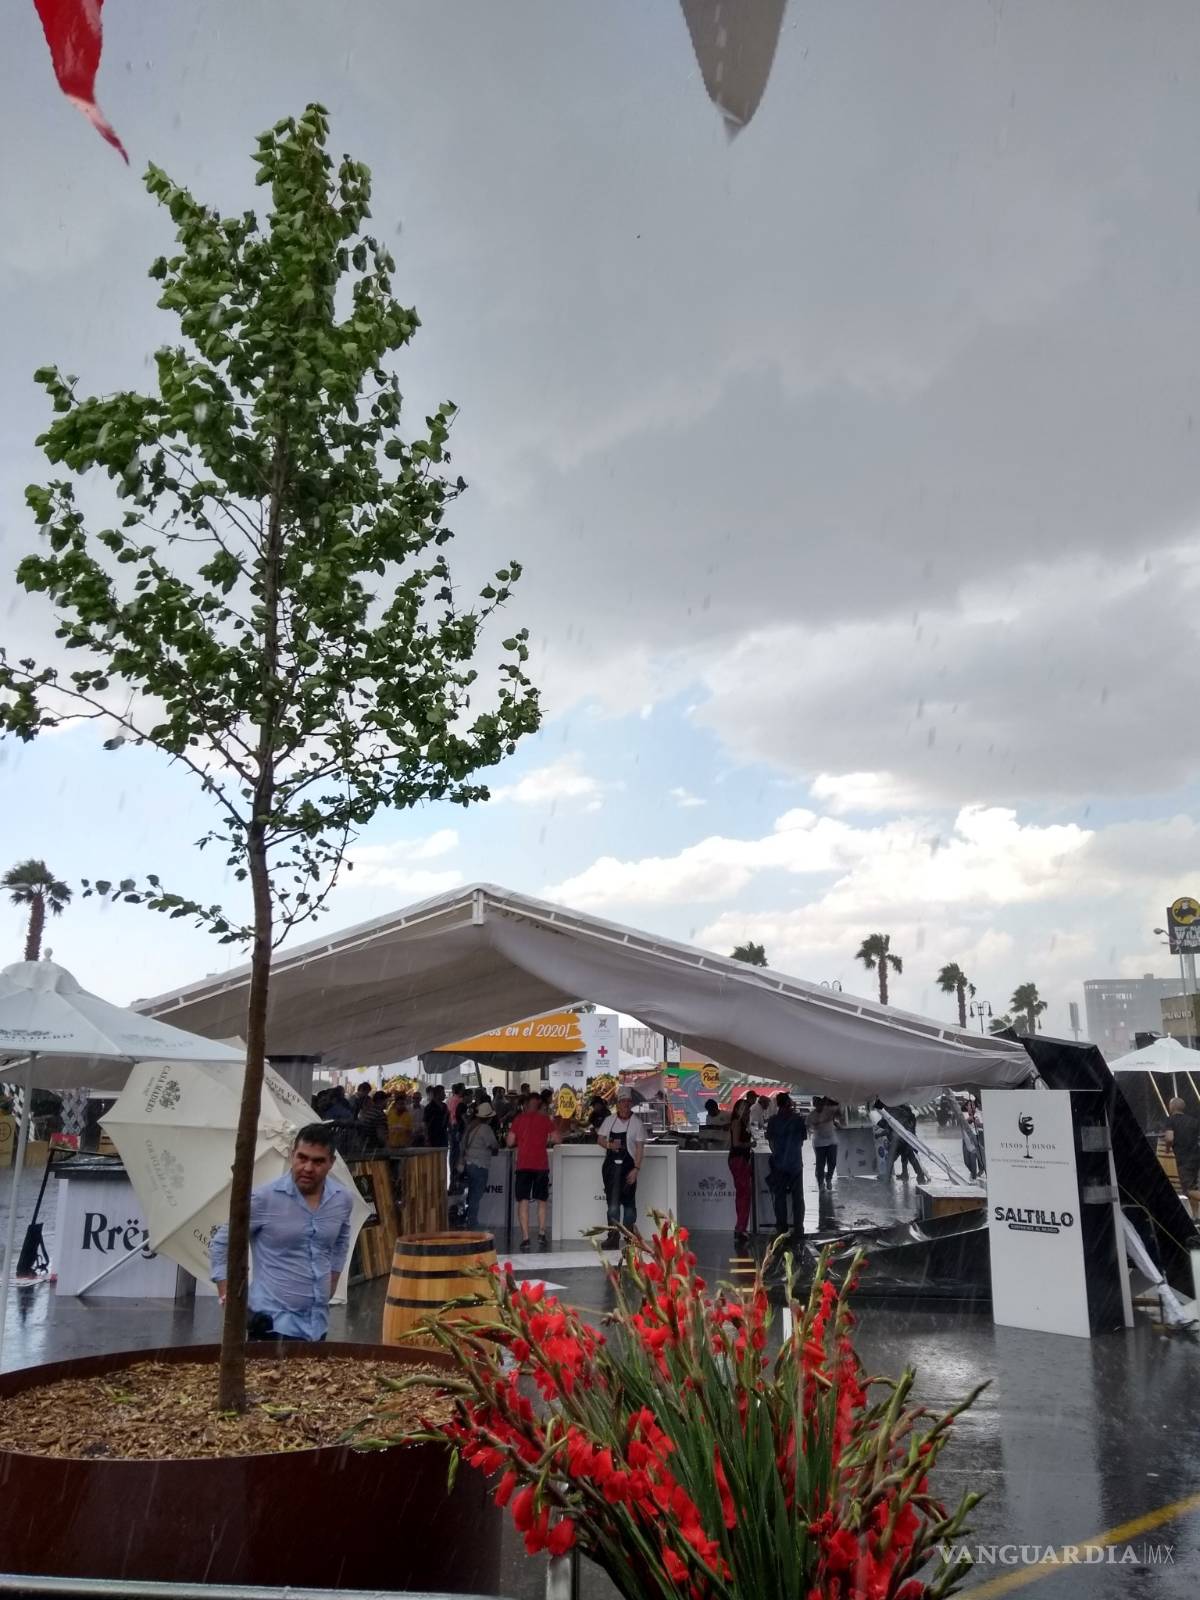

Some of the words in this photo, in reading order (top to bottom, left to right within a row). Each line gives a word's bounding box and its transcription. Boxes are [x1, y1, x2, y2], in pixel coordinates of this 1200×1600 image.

[505, 1025, 518, 1037] en
[522, 1021, 534, 1037] el
[535, 1023, 569, 1037] 2020!
[994, 1206, 1074, 1227] SALTILLO
